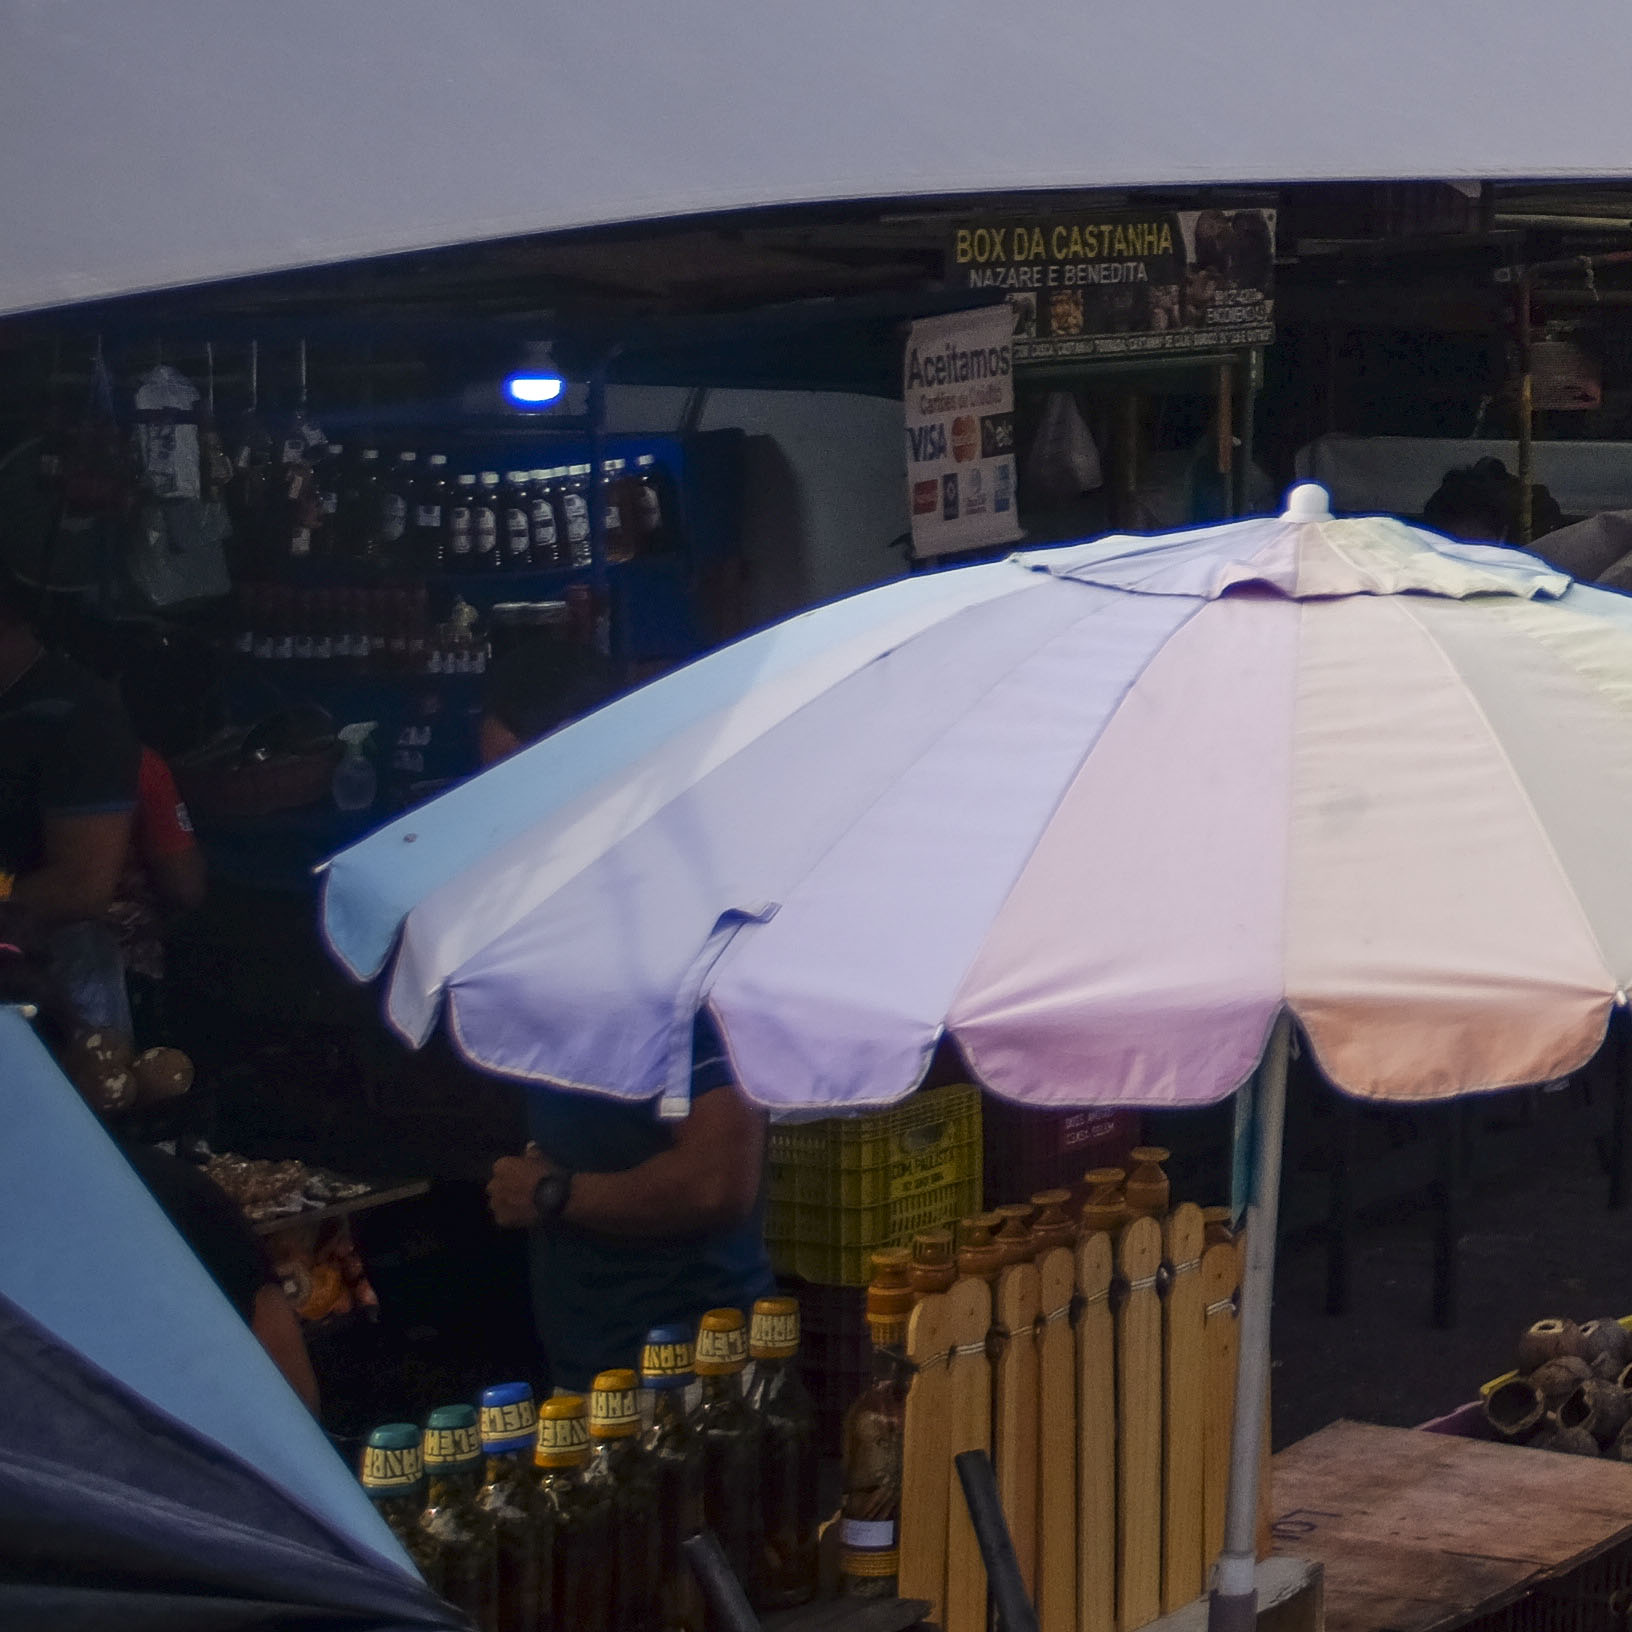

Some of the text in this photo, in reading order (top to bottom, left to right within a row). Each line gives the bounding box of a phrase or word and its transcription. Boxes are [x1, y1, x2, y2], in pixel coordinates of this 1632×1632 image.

[956, 222, 1173, 264] BOX DA CASTANHA
[1050, 265, 1061, 286] E
[1064, 261, 1149, 285] BENEDITA
[907, 344, 1010, 390] Aceitamos
[905, 422, 948, 462] VISA
